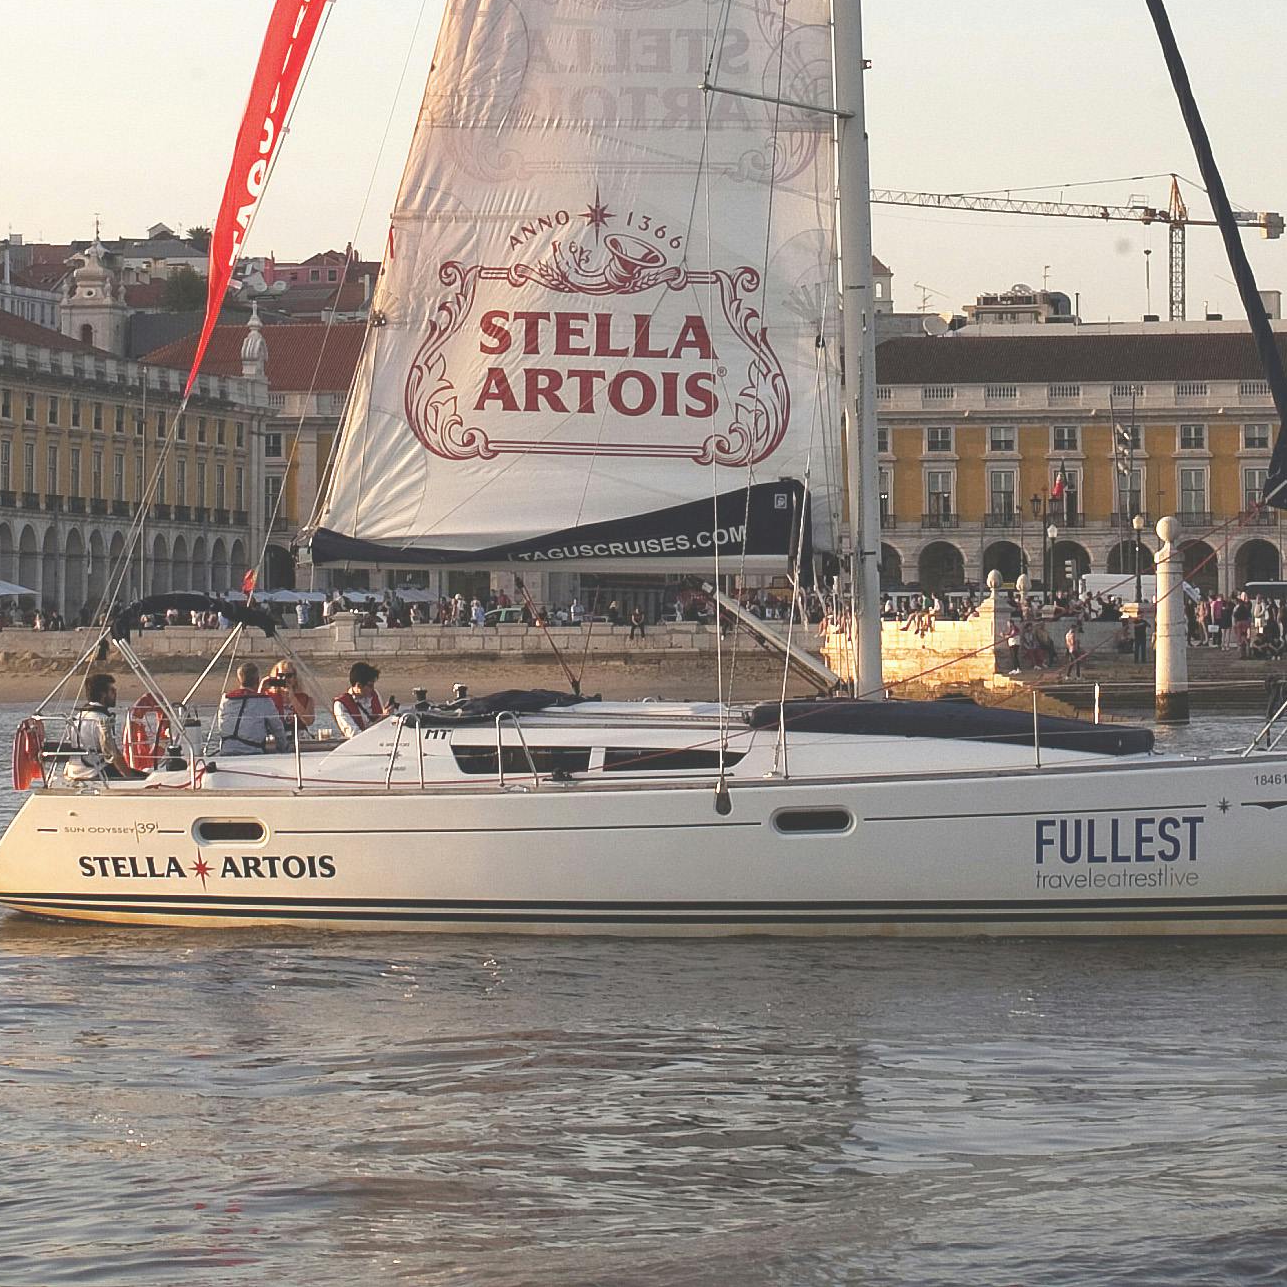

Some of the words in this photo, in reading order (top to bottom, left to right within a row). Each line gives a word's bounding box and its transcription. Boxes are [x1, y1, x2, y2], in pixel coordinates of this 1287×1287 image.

[509, 210, 569, 251] ANNO
[626, 211, 683, 249] 1366
[479, 310, 719, 360] STELLA
[473, 367, 719, 418] ARTOIS
[518, 525, 747, 561] TAGUSCRUISES.COM
[424, 729, 452, 740] MT
[1035, 816, 1204, 864] FULLEST
[78, 856, 187, 878] STELLA
[220, 855, 336, 878] ARTOIS
